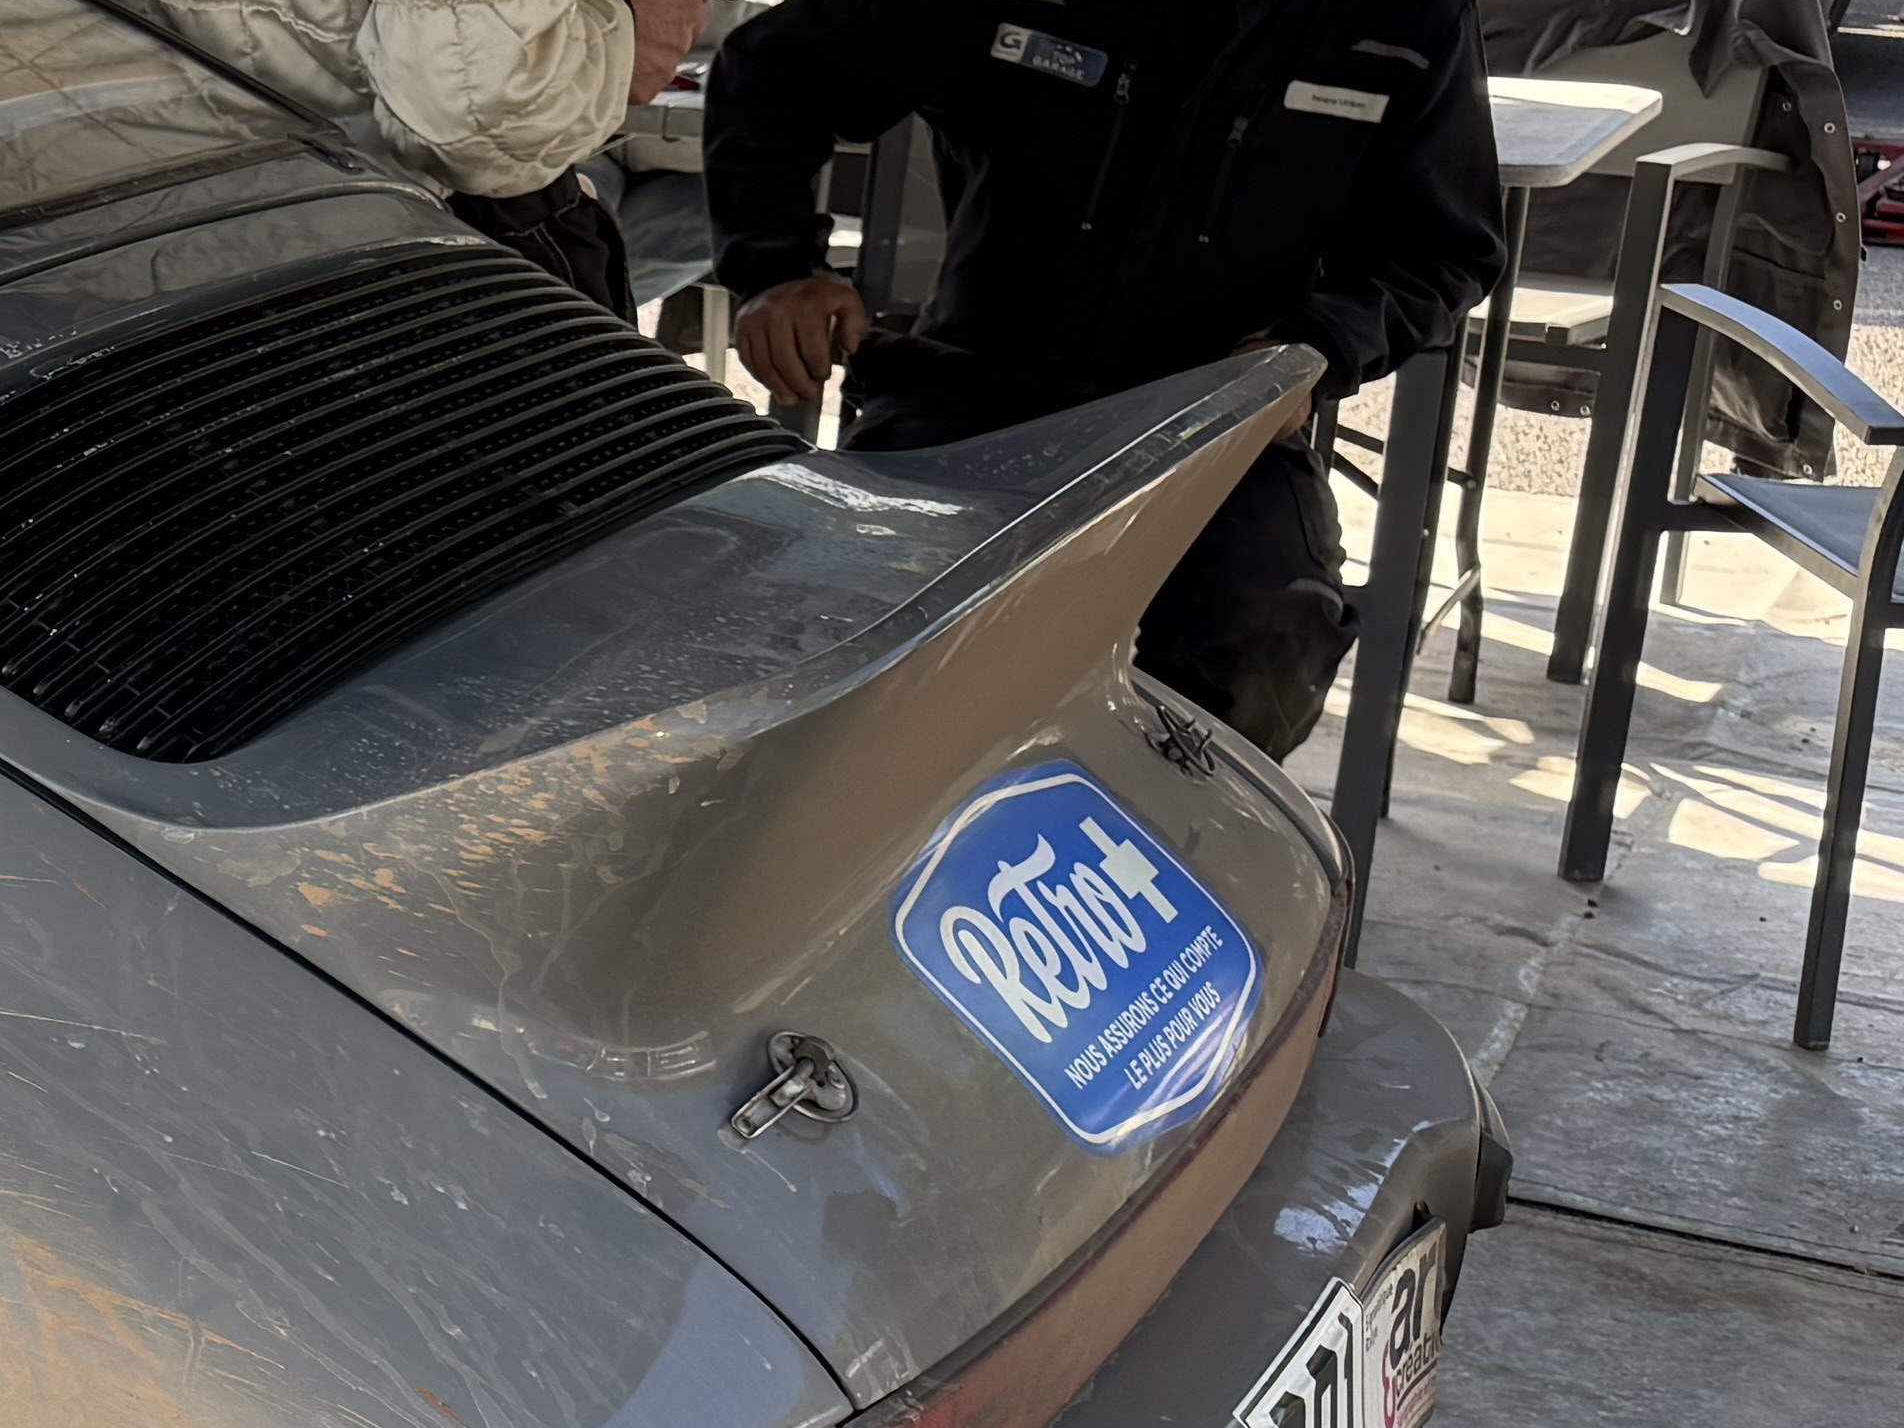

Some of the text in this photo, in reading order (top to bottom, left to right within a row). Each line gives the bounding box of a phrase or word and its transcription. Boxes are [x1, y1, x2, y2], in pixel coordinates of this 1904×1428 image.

[1063, 924, 1224, 1090] NOUS ASSURONS CE QUI COMPTE
[1123, 981, 1221, 1091] LE PLUS POUR VOUS
